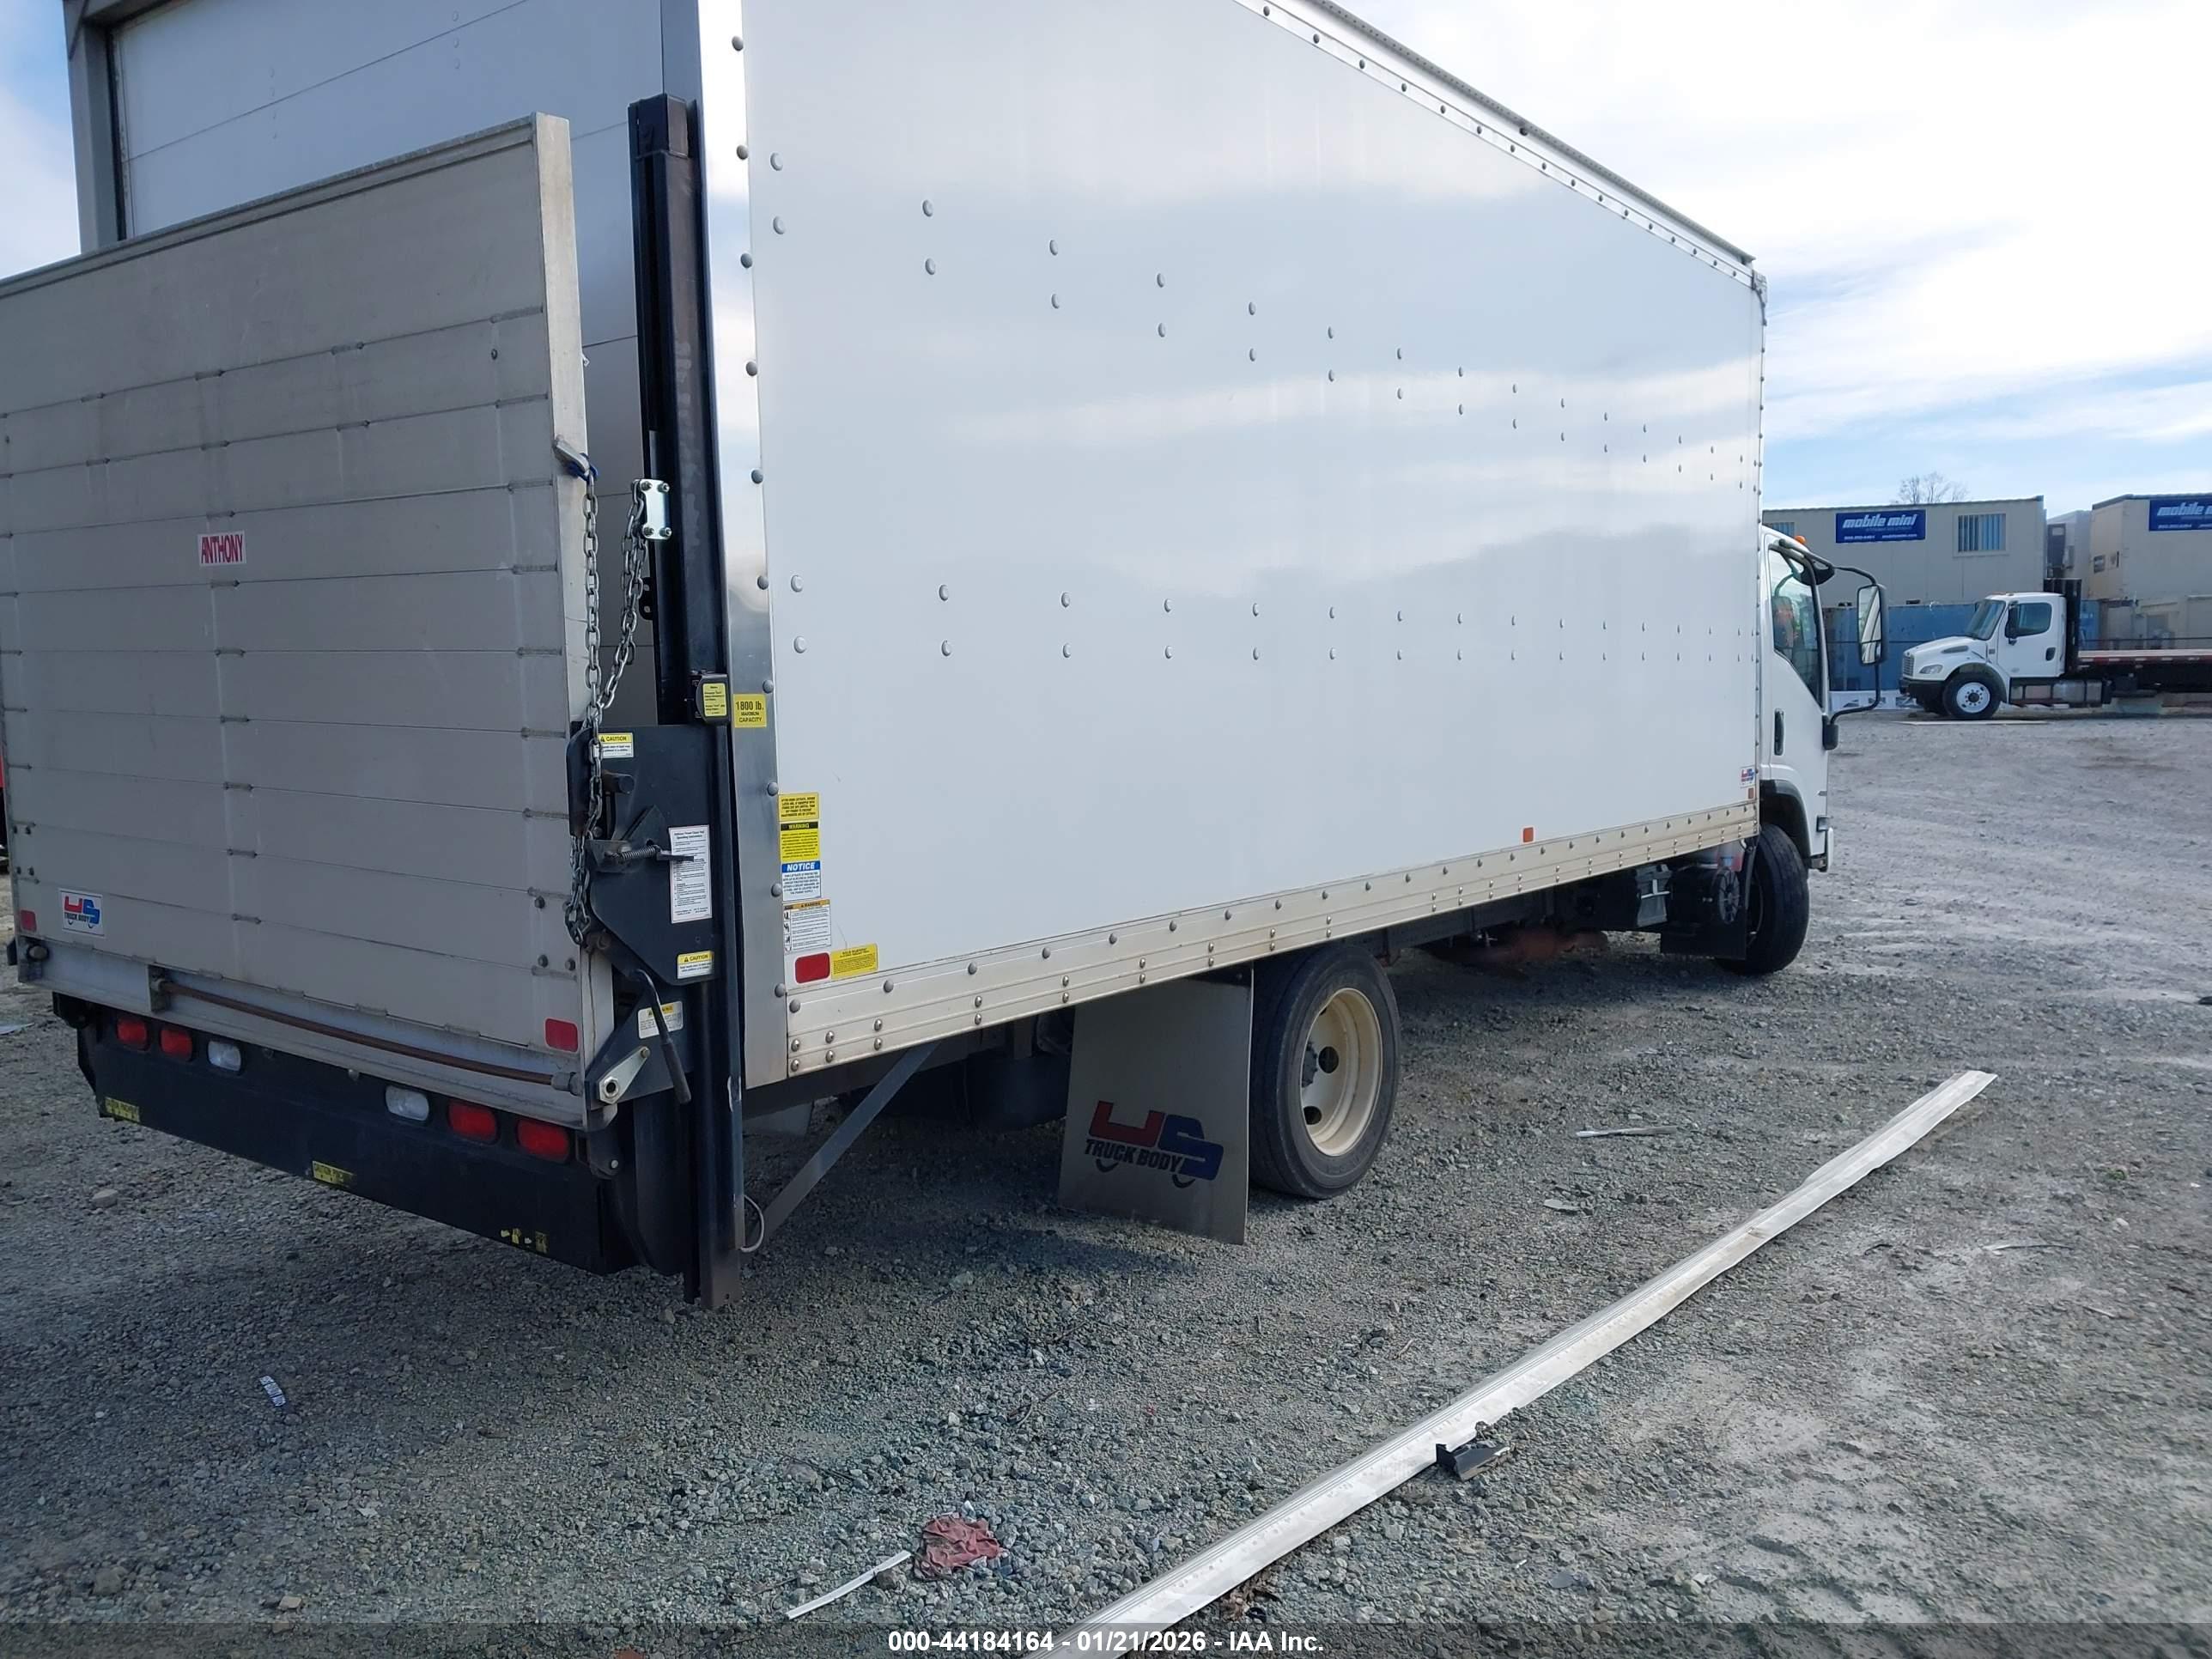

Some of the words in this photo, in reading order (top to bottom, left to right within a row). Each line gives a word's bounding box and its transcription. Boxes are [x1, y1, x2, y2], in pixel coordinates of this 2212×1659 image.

[2157, 501, 2204, 516] mobile
[1842, 514, 1887, 529] mobile
[1887, 514, 1917, 526] mini
[201, 533, 243, 564] ANTHONY
[736, 701, 754, 711] 1800
[755, 700, 764, 711] lb.
[787, 861, 816, 872] NOTICE
[64, 896, 100, 925] US
[689, 953, 708, 962] CAUTION
[1088, 1100, 1224, 1182] US
[1085, 1139, 1137, 1164] TRUCK
[1136, 1148, 1184, 1173] BODY
